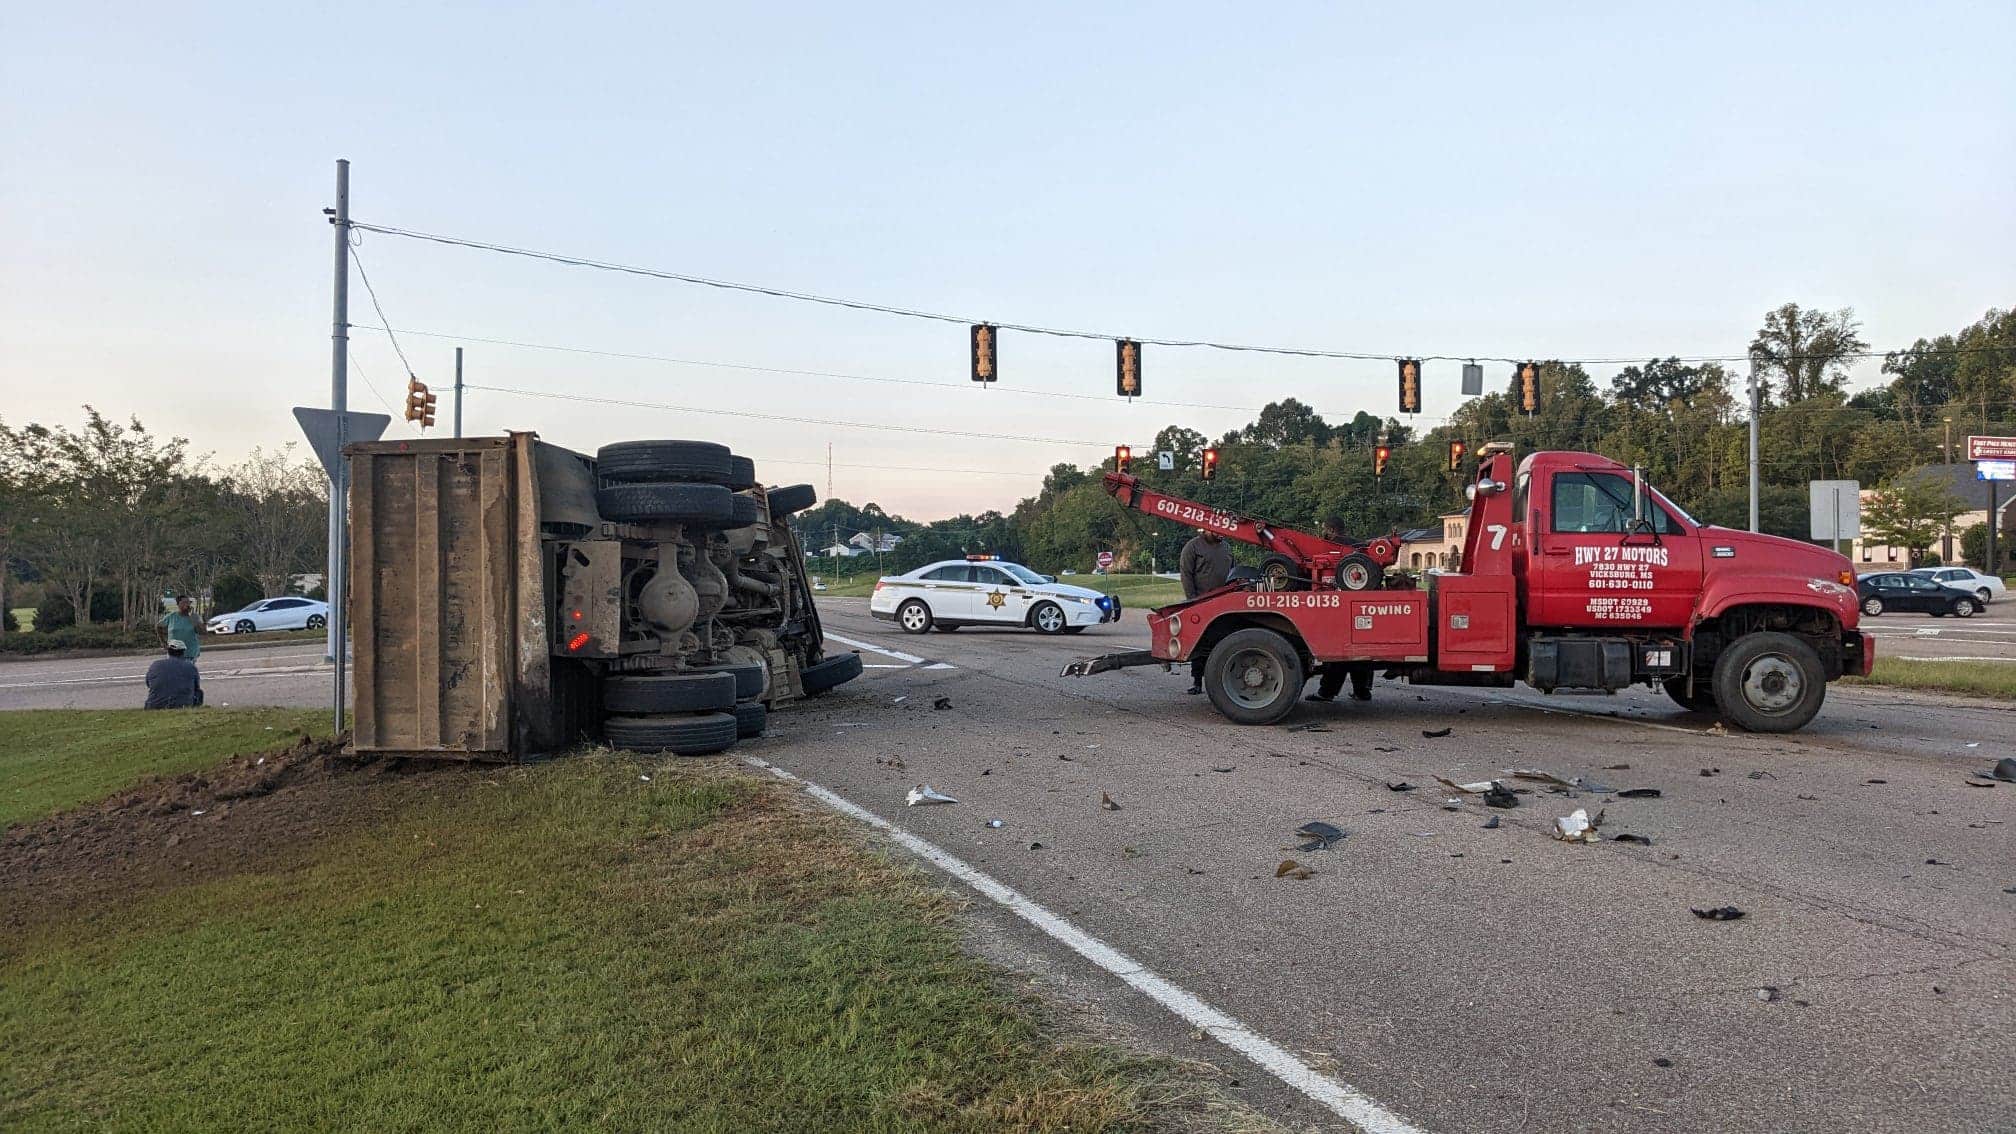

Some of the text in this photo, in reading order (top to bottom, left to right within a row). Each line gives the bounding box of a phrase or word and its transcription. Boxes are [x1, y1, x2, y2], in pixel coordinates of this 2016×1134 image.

[1487, 525, 1507, 550] 7
[1575, 547, 1668, 566] HWY 27 MOTORS
[1589, 580, 1653, 589] 601-630-0110
[1247, 595, 1340, 608] 601-218-0138
[1360, 605, 1411, 615] TOWING
[1586, 605, 1614, 613] USDOT
